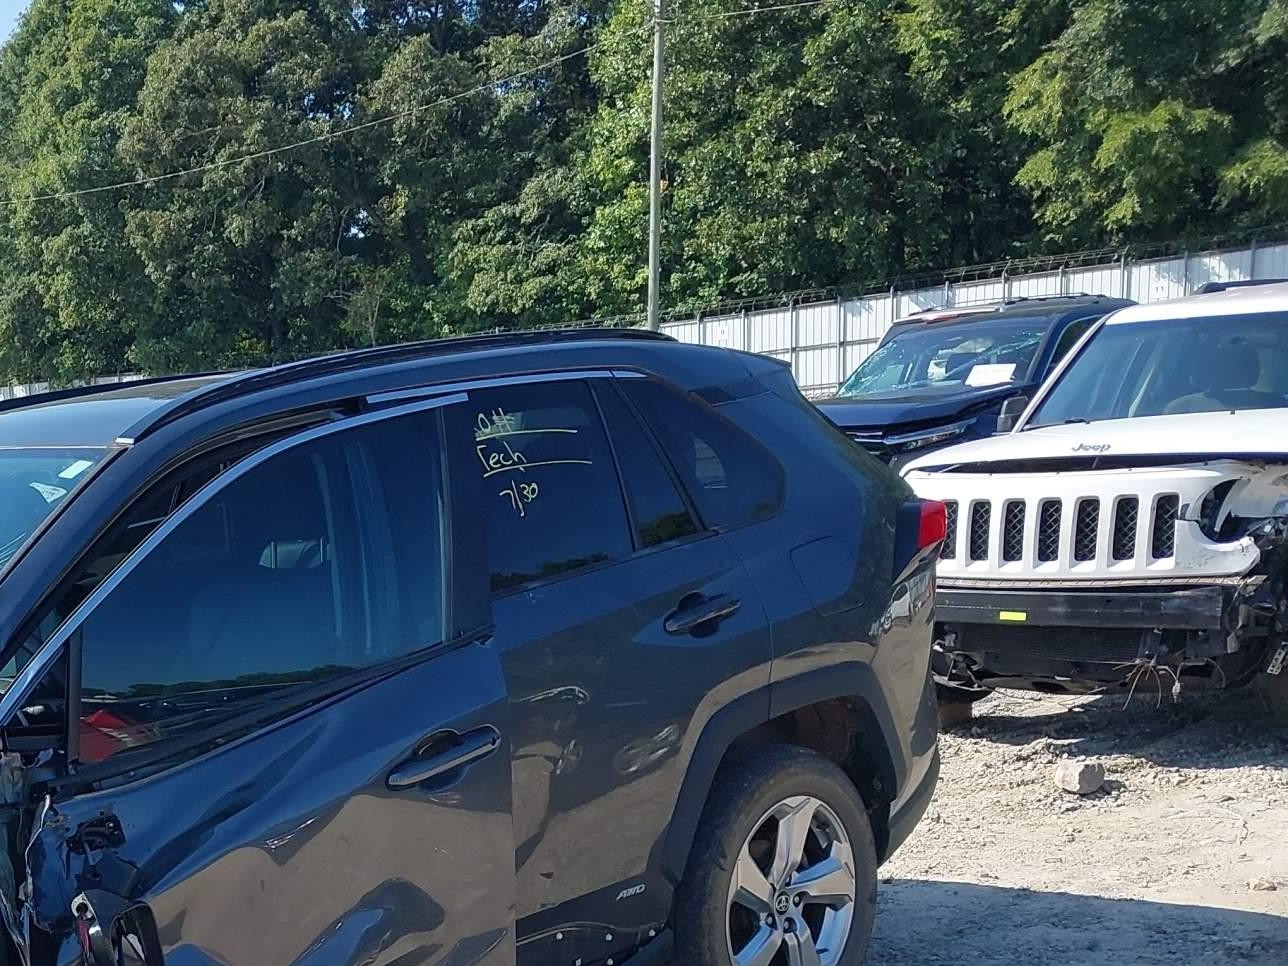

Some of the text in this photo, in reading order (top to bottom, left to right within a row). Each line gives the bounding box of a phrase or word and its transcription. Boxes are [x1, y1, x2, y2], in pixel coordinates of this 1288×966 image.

[476, 441, 527, 472] Tech
[1071, 443, 1111, 453] Jeep
[499, 480, 539, 517] 7/30
